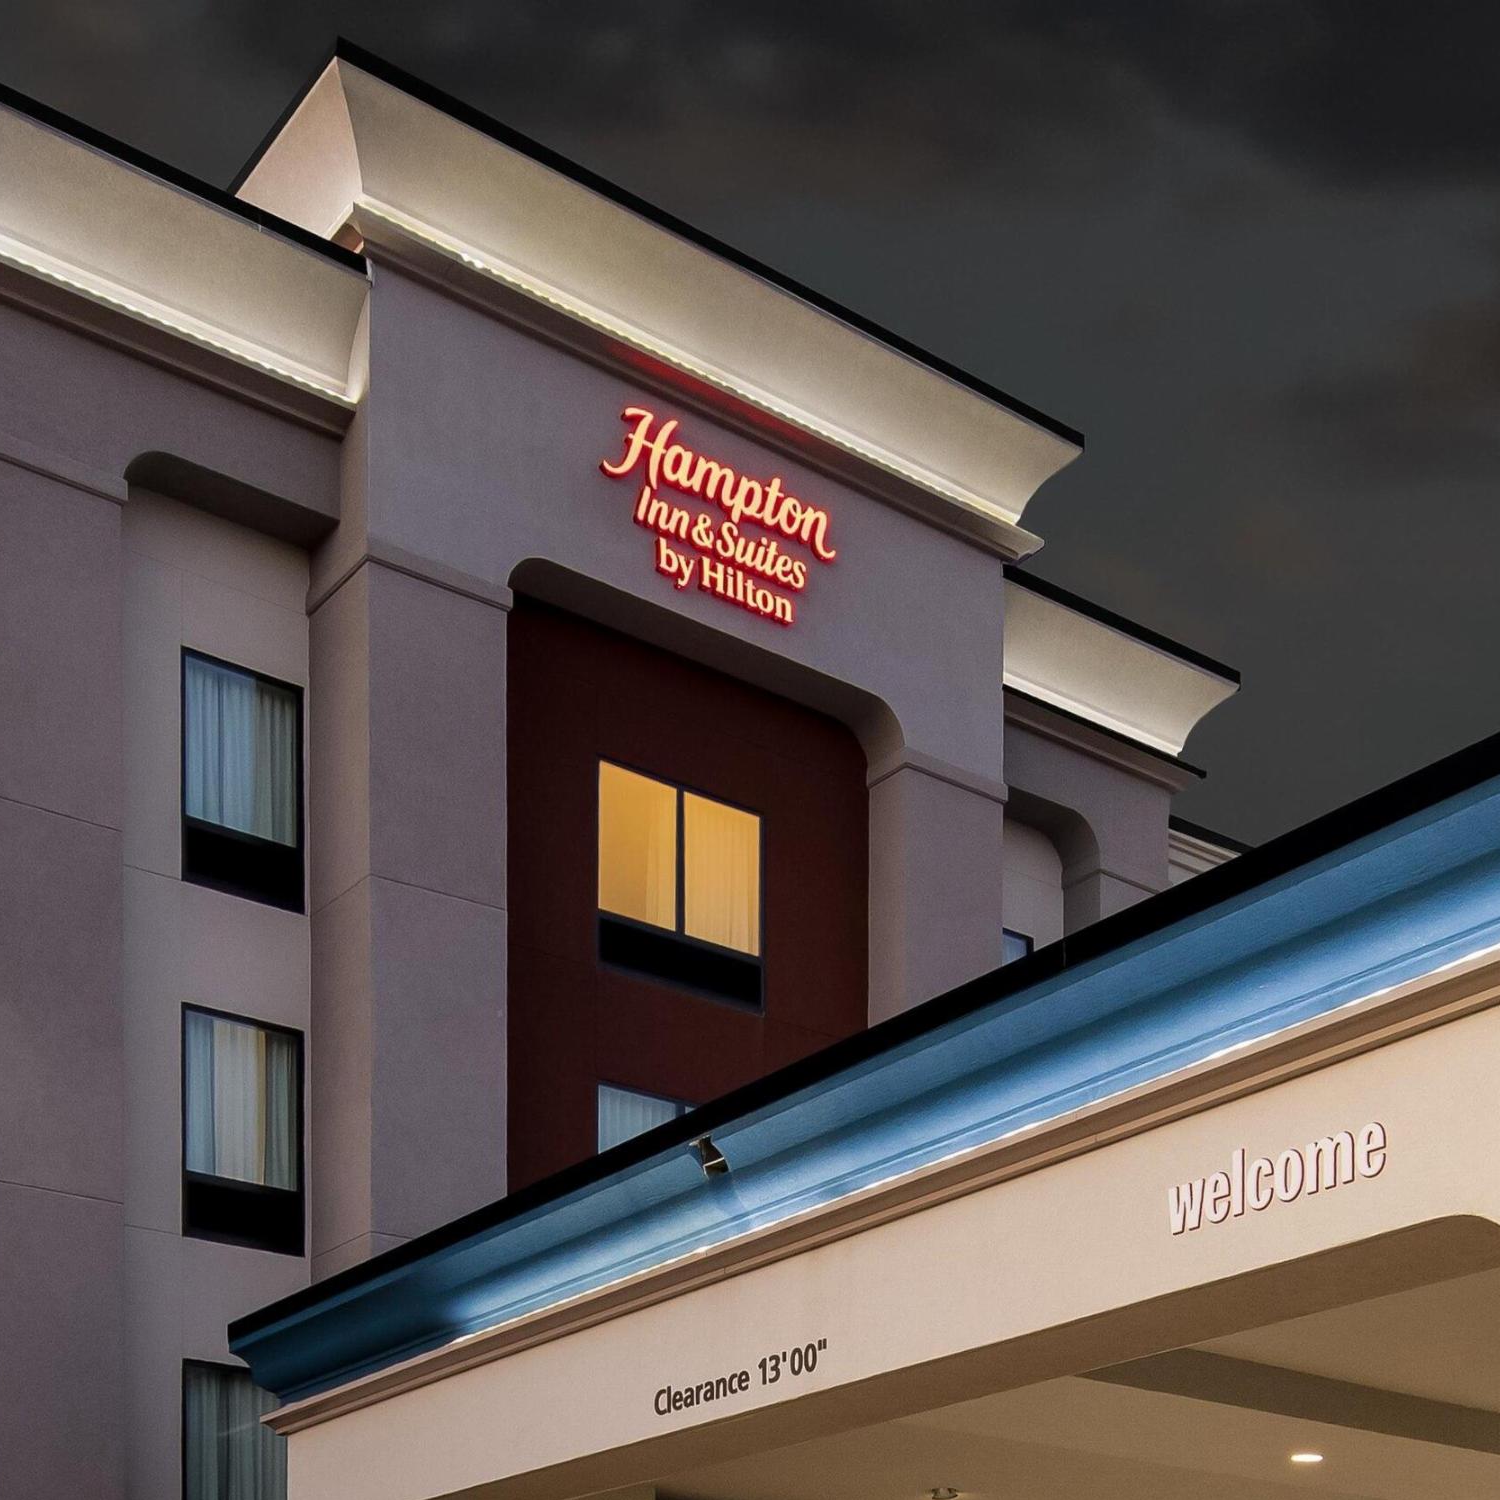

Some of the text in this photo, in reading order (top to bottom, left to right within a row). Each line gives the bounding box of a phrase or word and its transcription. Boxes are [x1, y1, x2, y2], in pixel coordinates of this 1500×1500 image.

[601, 406, 836, 560] Hampton
[635, 485, 690, 538] Inn
[715, 521, 807, 588] Suites
[656, 537, 794, 624] by Hilton
[1168, 1122, 1387, 1235] welcome
[654, 1370, 750, 1416] Clearance
